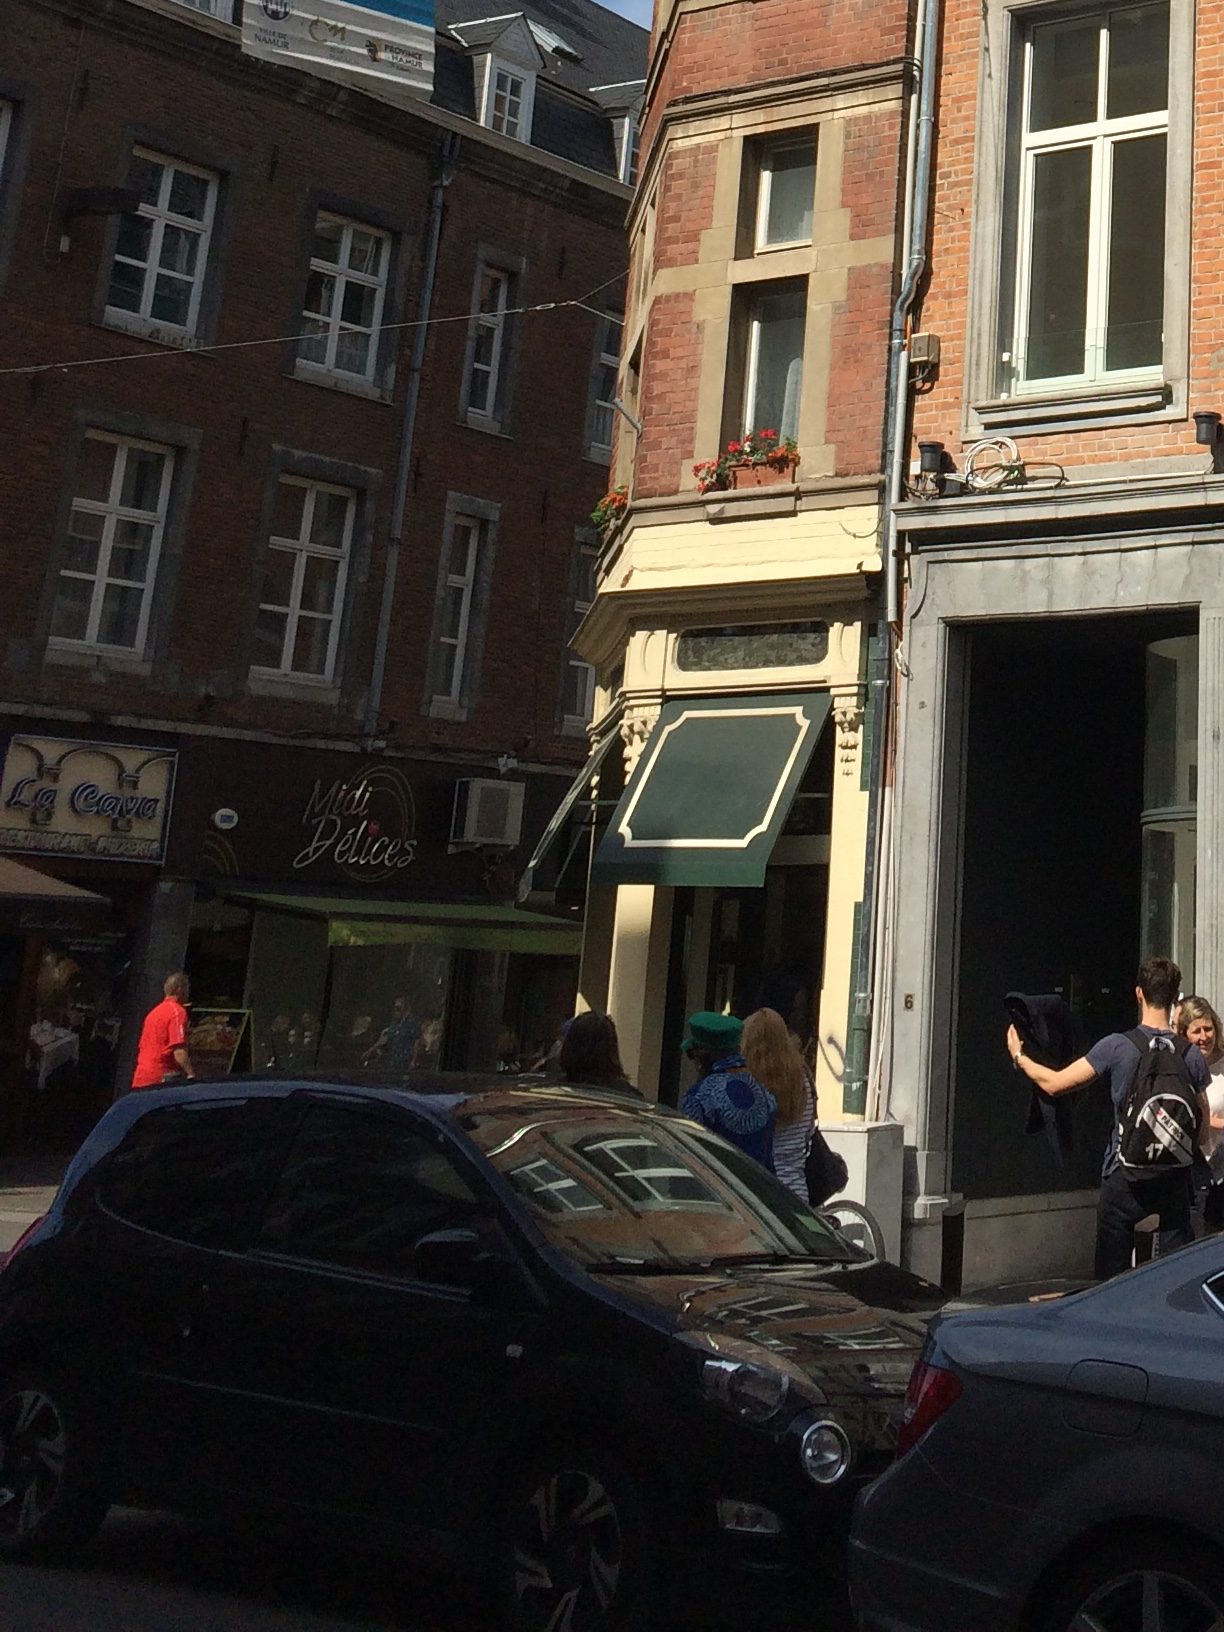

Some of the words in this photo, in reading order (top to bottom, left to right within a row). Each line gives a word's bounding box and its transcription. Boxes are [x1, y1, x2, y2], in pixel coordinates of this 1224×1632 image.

[254, 33, 290, 50] NAMUR
[384, 44, 423, 61] PROVINCE
[6, 778, 57, 810] La
[70, 782, 160, 820] Cava
[303, 779, 372, 824] Midi
[293, 815, 418, 868] Délices
[905, 994, 914, 1009] 6
[1161, 1115, 1184, 1140] PATRICK
[1145, 1143, 1164, 1160] 17
